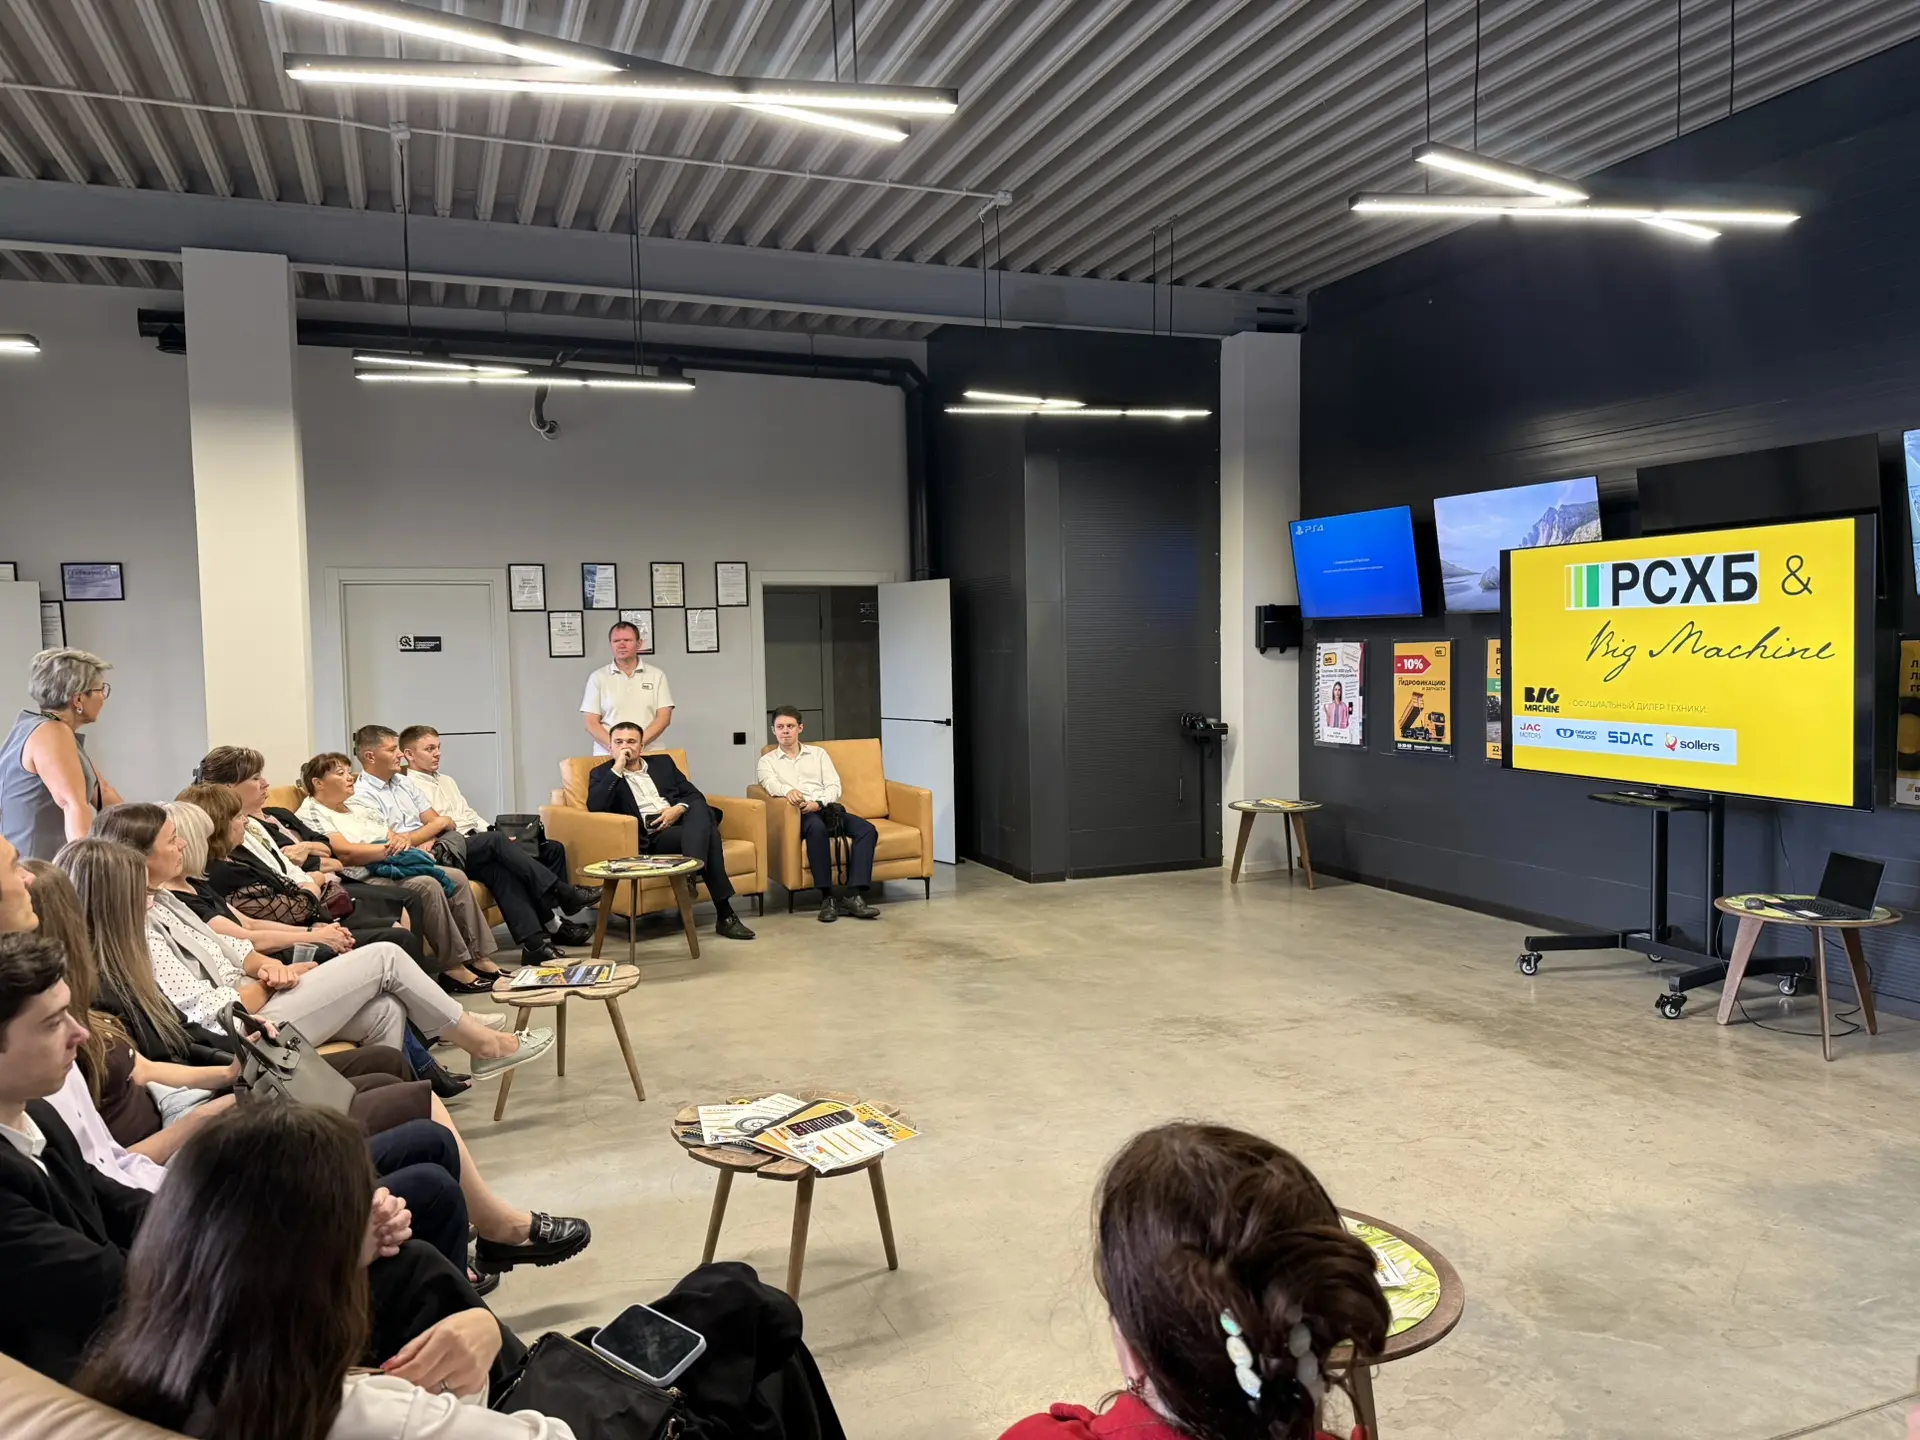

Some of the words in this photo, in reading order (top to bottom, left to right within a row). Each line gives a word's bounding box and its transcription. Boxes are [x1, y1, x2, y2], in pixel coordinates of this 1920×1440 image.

[1305, 525, 1324, 533] PS4
[1611, 553, 1758, 606] РСХБ
[1781, 554, 1812, 595] &
[1586, 620, 1637, 682] Big
[1649, 620, 1835, 660] Machine
[1524, 687, 1560, 704] BIG
[1524, 704, 1560, 714] MACHINE
[1572, 699, 1635, 710] ОФИЦИАЛЬНЫЙ
[1636, 702, 1665, 711] ДИЛЕР
[1520, 723, 1541, 732] JAC
[1519, 731, 1541, 740] MOTORS
[1608, 731, 1653, 746] SDAC
[1680, 740, 1720, 752] sollers
